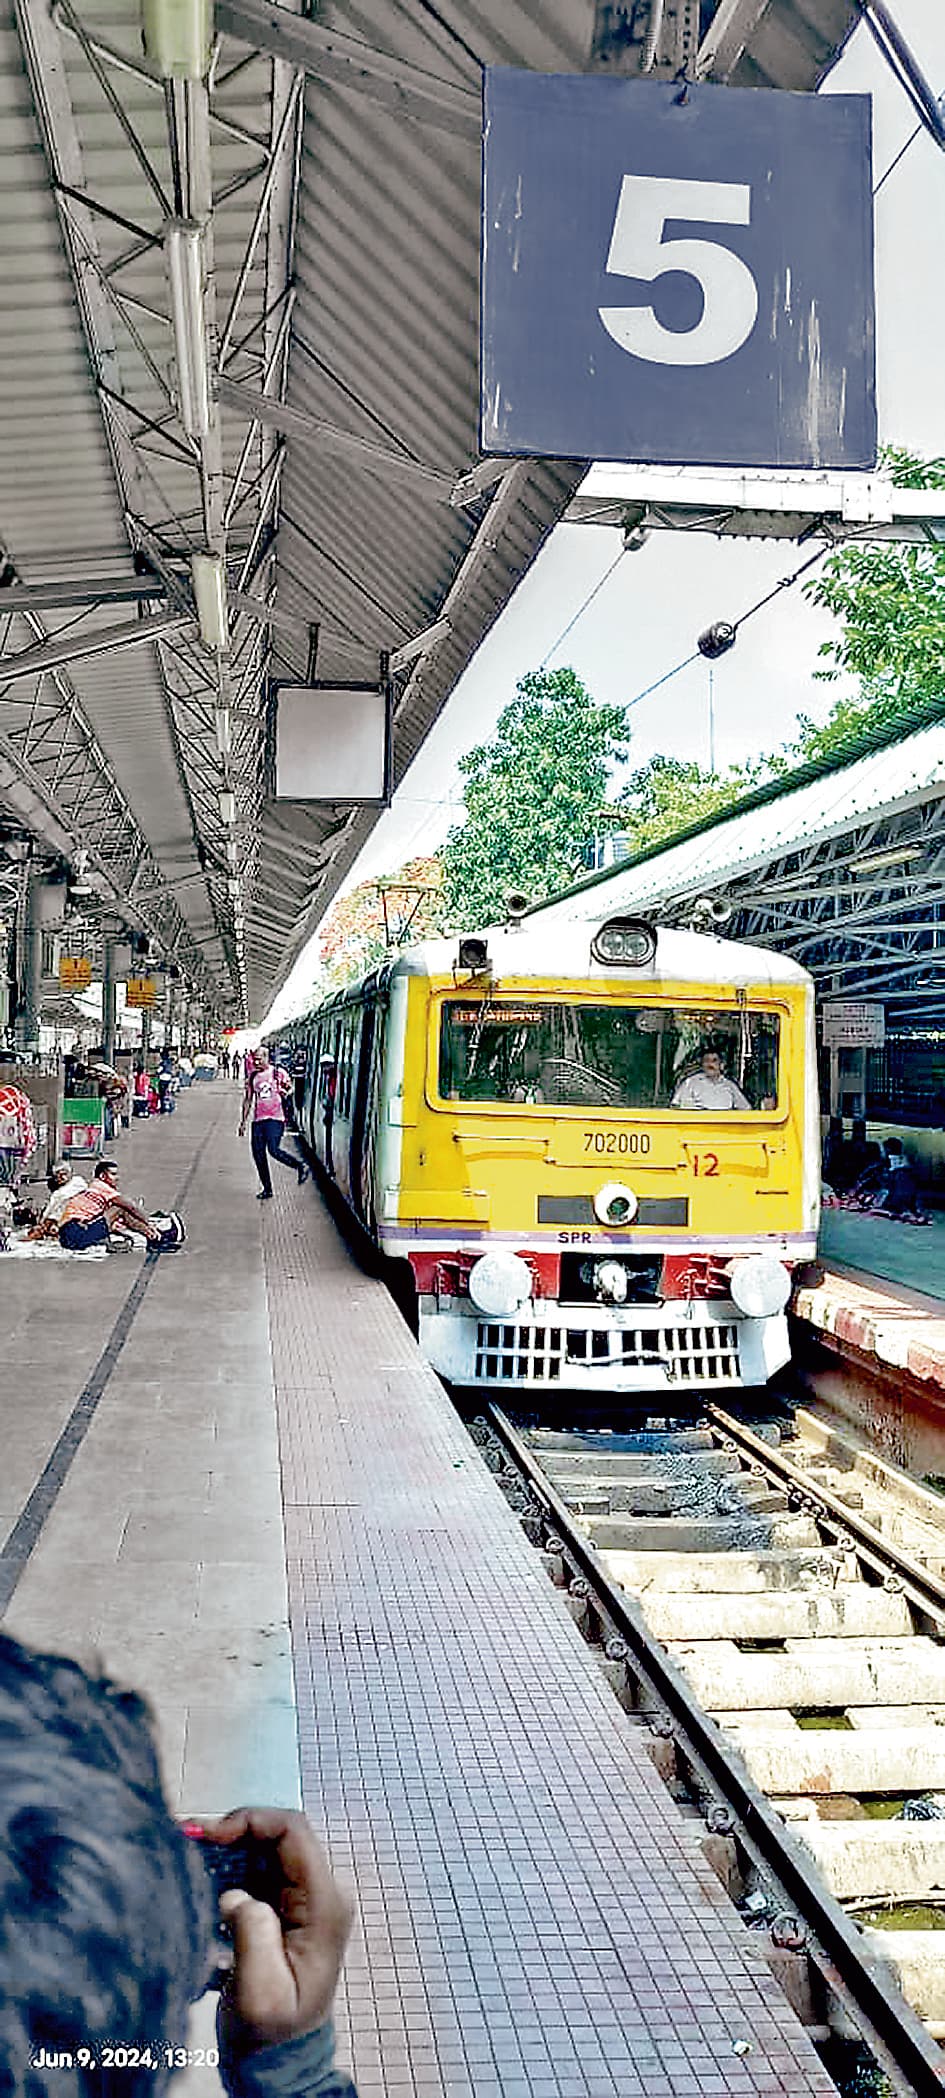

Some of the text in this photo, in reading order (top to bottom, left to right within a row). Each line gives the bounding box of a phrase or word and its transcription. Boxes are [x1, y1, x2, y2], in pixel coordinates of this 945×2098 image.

[598, 174, 759, 366] 5
[583, 1133, 651, 1154] 702000
[692, 1152, 720, 1177] 12
[557, 1231, 593, 1244] SPR
